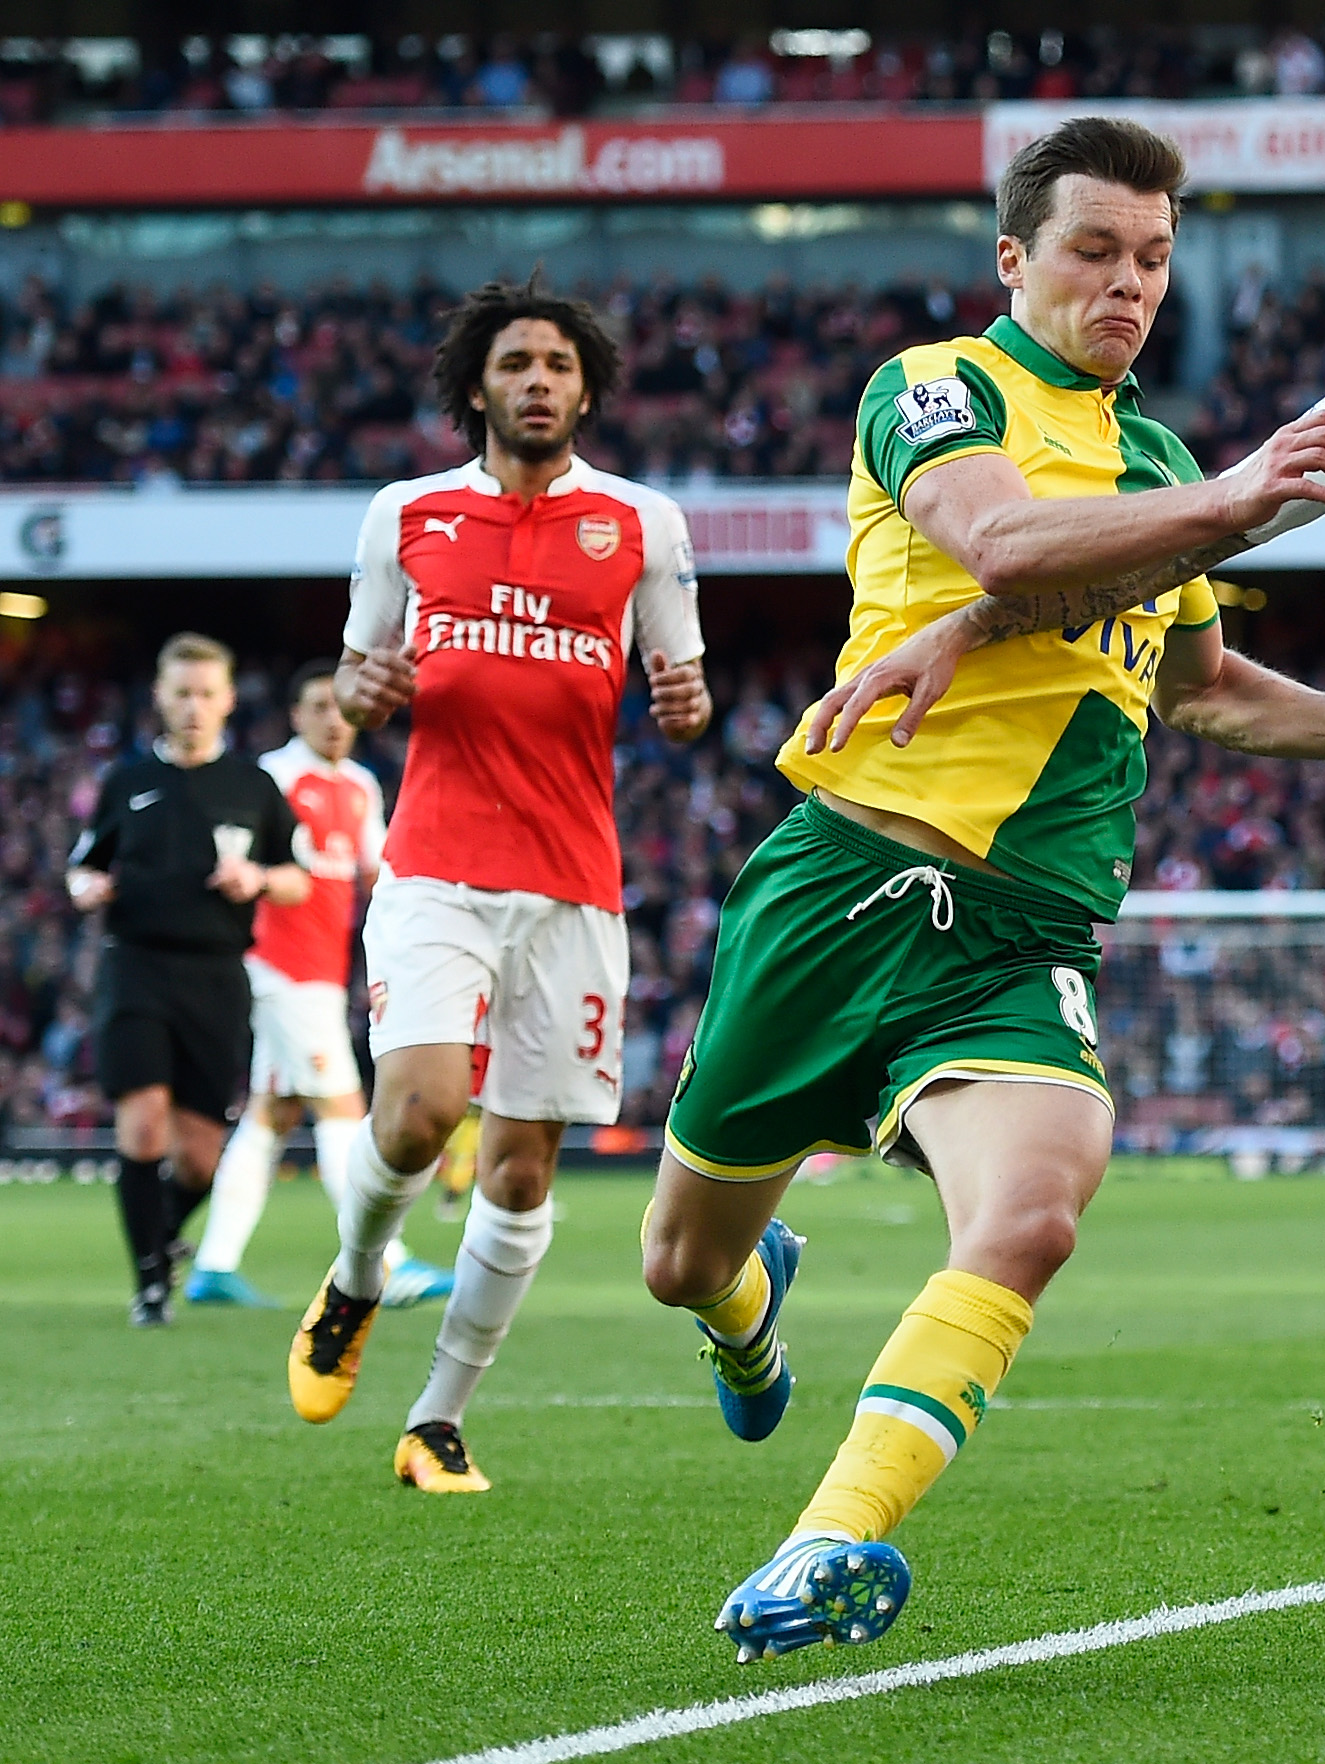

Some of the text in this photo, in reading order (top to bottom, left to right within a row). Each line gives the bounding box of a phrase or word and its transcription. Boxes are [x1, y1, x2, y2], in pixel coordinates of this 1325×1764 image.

[363, 125, 725, 194] Arsenal.com
[491, 584, 550, 624] Fly
[427, 612, 613, 670] Emirates
[1051, 966, 1097, 1046] 8
